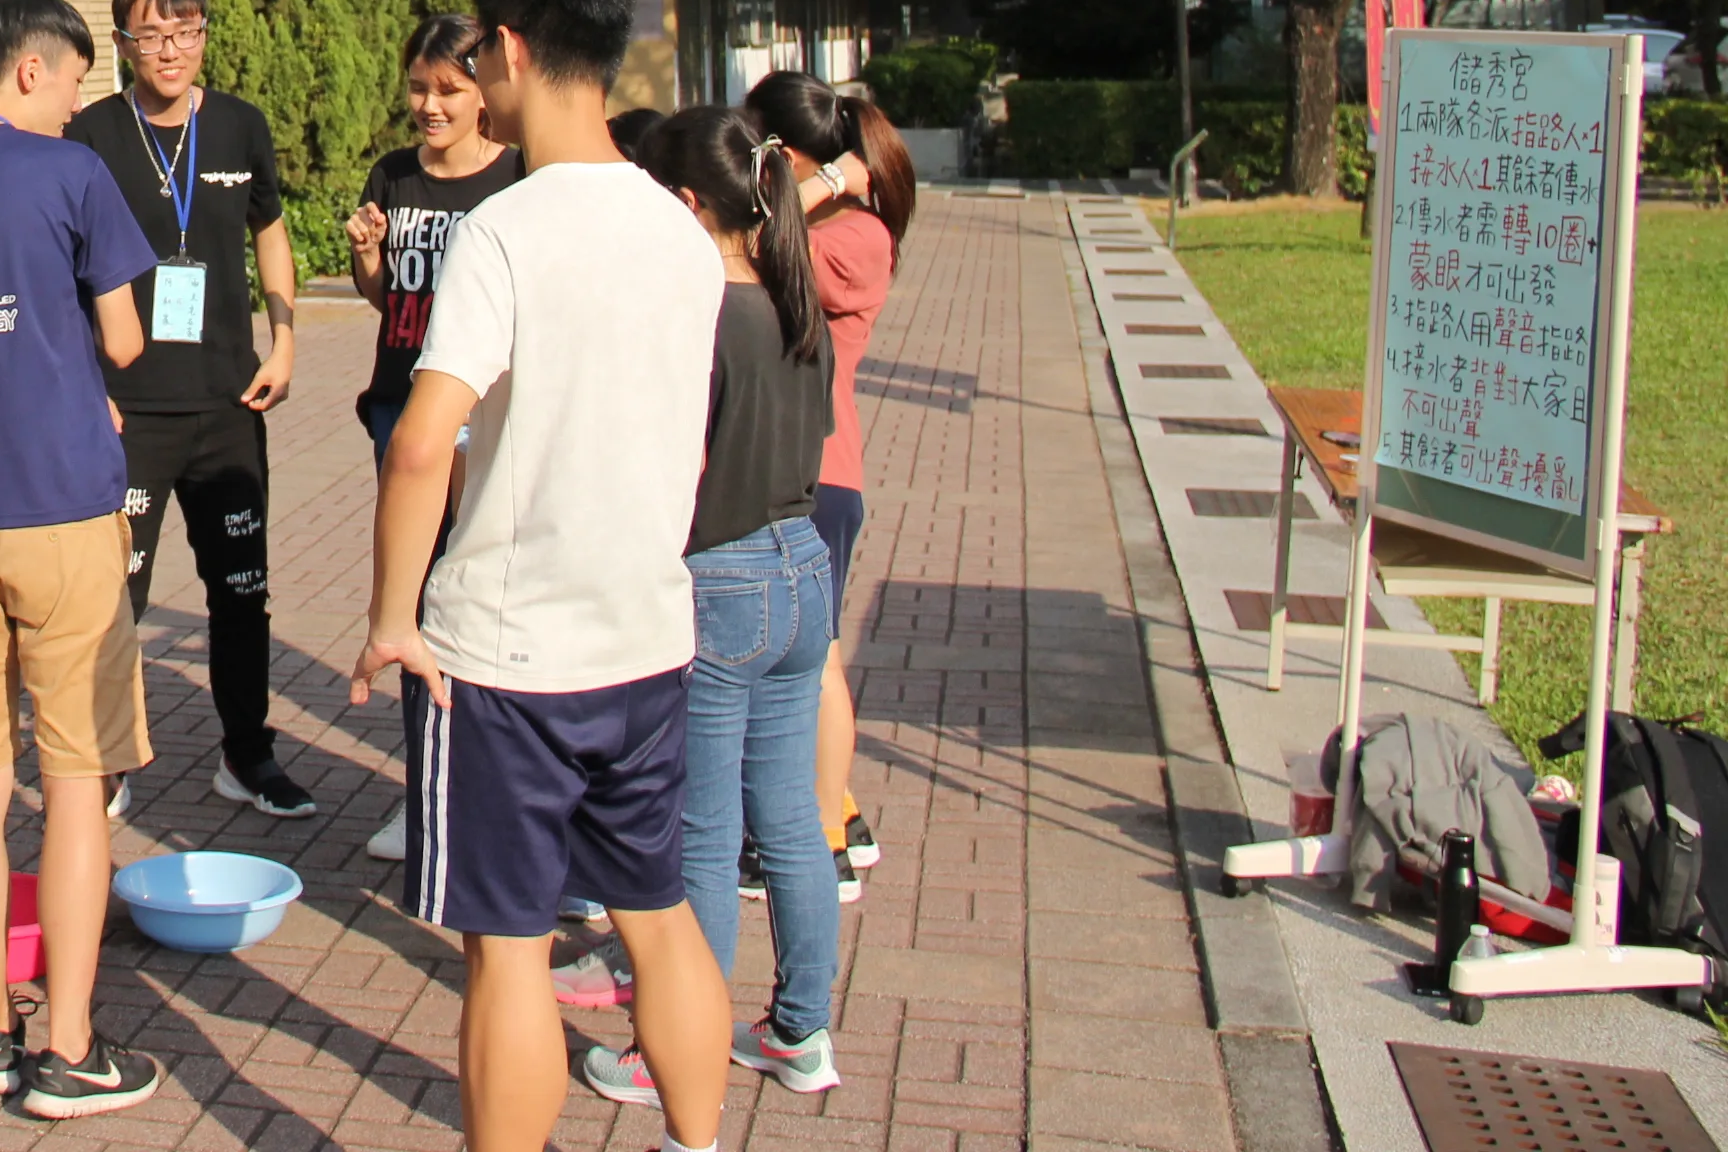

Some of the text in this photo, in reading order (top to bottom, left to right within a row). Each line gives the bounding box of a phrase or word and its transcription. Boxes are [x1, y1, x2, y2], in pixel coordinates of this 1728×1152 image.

[1450, 48, 1534, 101] 儲秀宮
[1409, 239, 1556, 307] 蒙眼才可出發
[1402, 388, 1484, 440] 不可出聲
